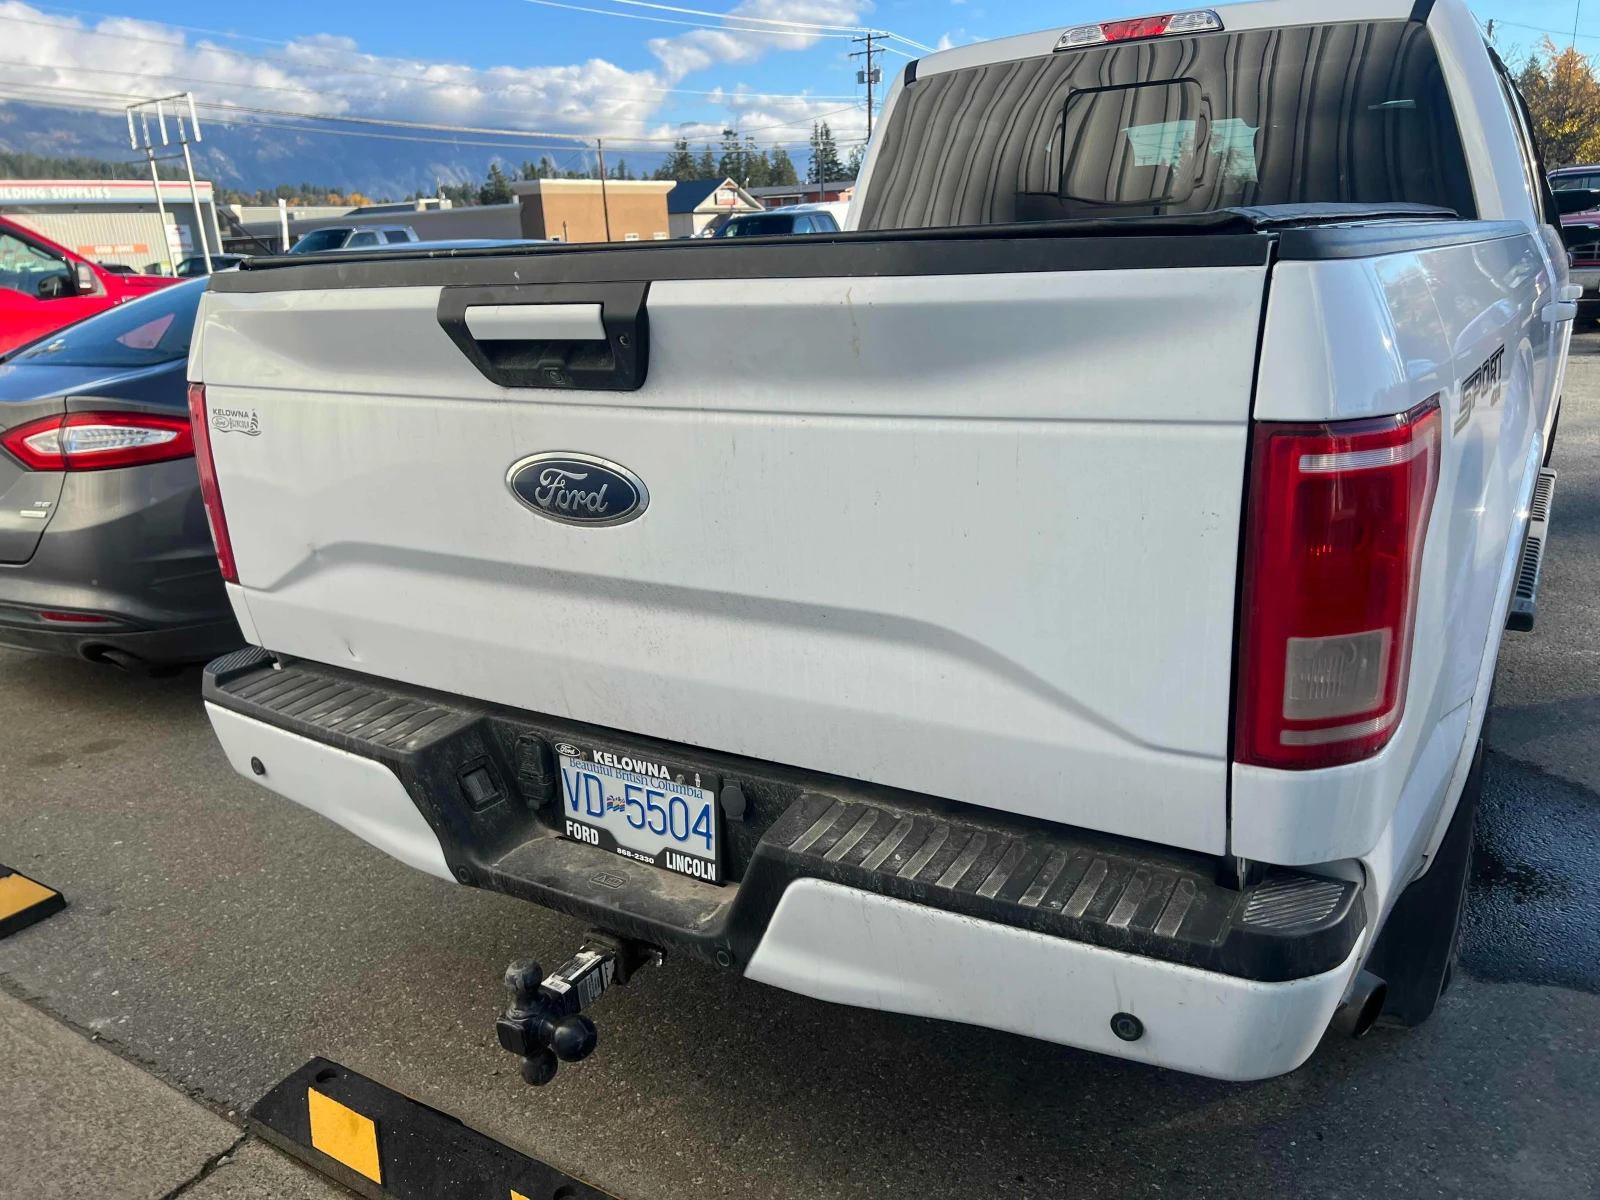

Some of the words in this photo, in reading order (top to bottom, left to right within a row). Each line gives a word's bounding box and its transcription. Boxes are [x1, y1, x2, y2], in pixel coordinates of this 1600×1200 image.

[50, 186, 111, 199] SUPPLIES
[1453, 343, 1505, 438] SPORT
[212, 408, 249, 419] KELOWNA
[534, 467, 609, 513] Ford
[569, 757, 613, 777] Beautiful
[615, 769, 649, 786] British
[650, 778, 704, 800] Columbia
[592, 750, 671, 780] KELOWNA
[562, 767, 606, 819] VD
[624, 783, 713, 851] 5504
[565, 820, 599, 846] FORD
[616, 847, 655, 865] 868-2330
[665, 851, 716, 881] LINCOLN
